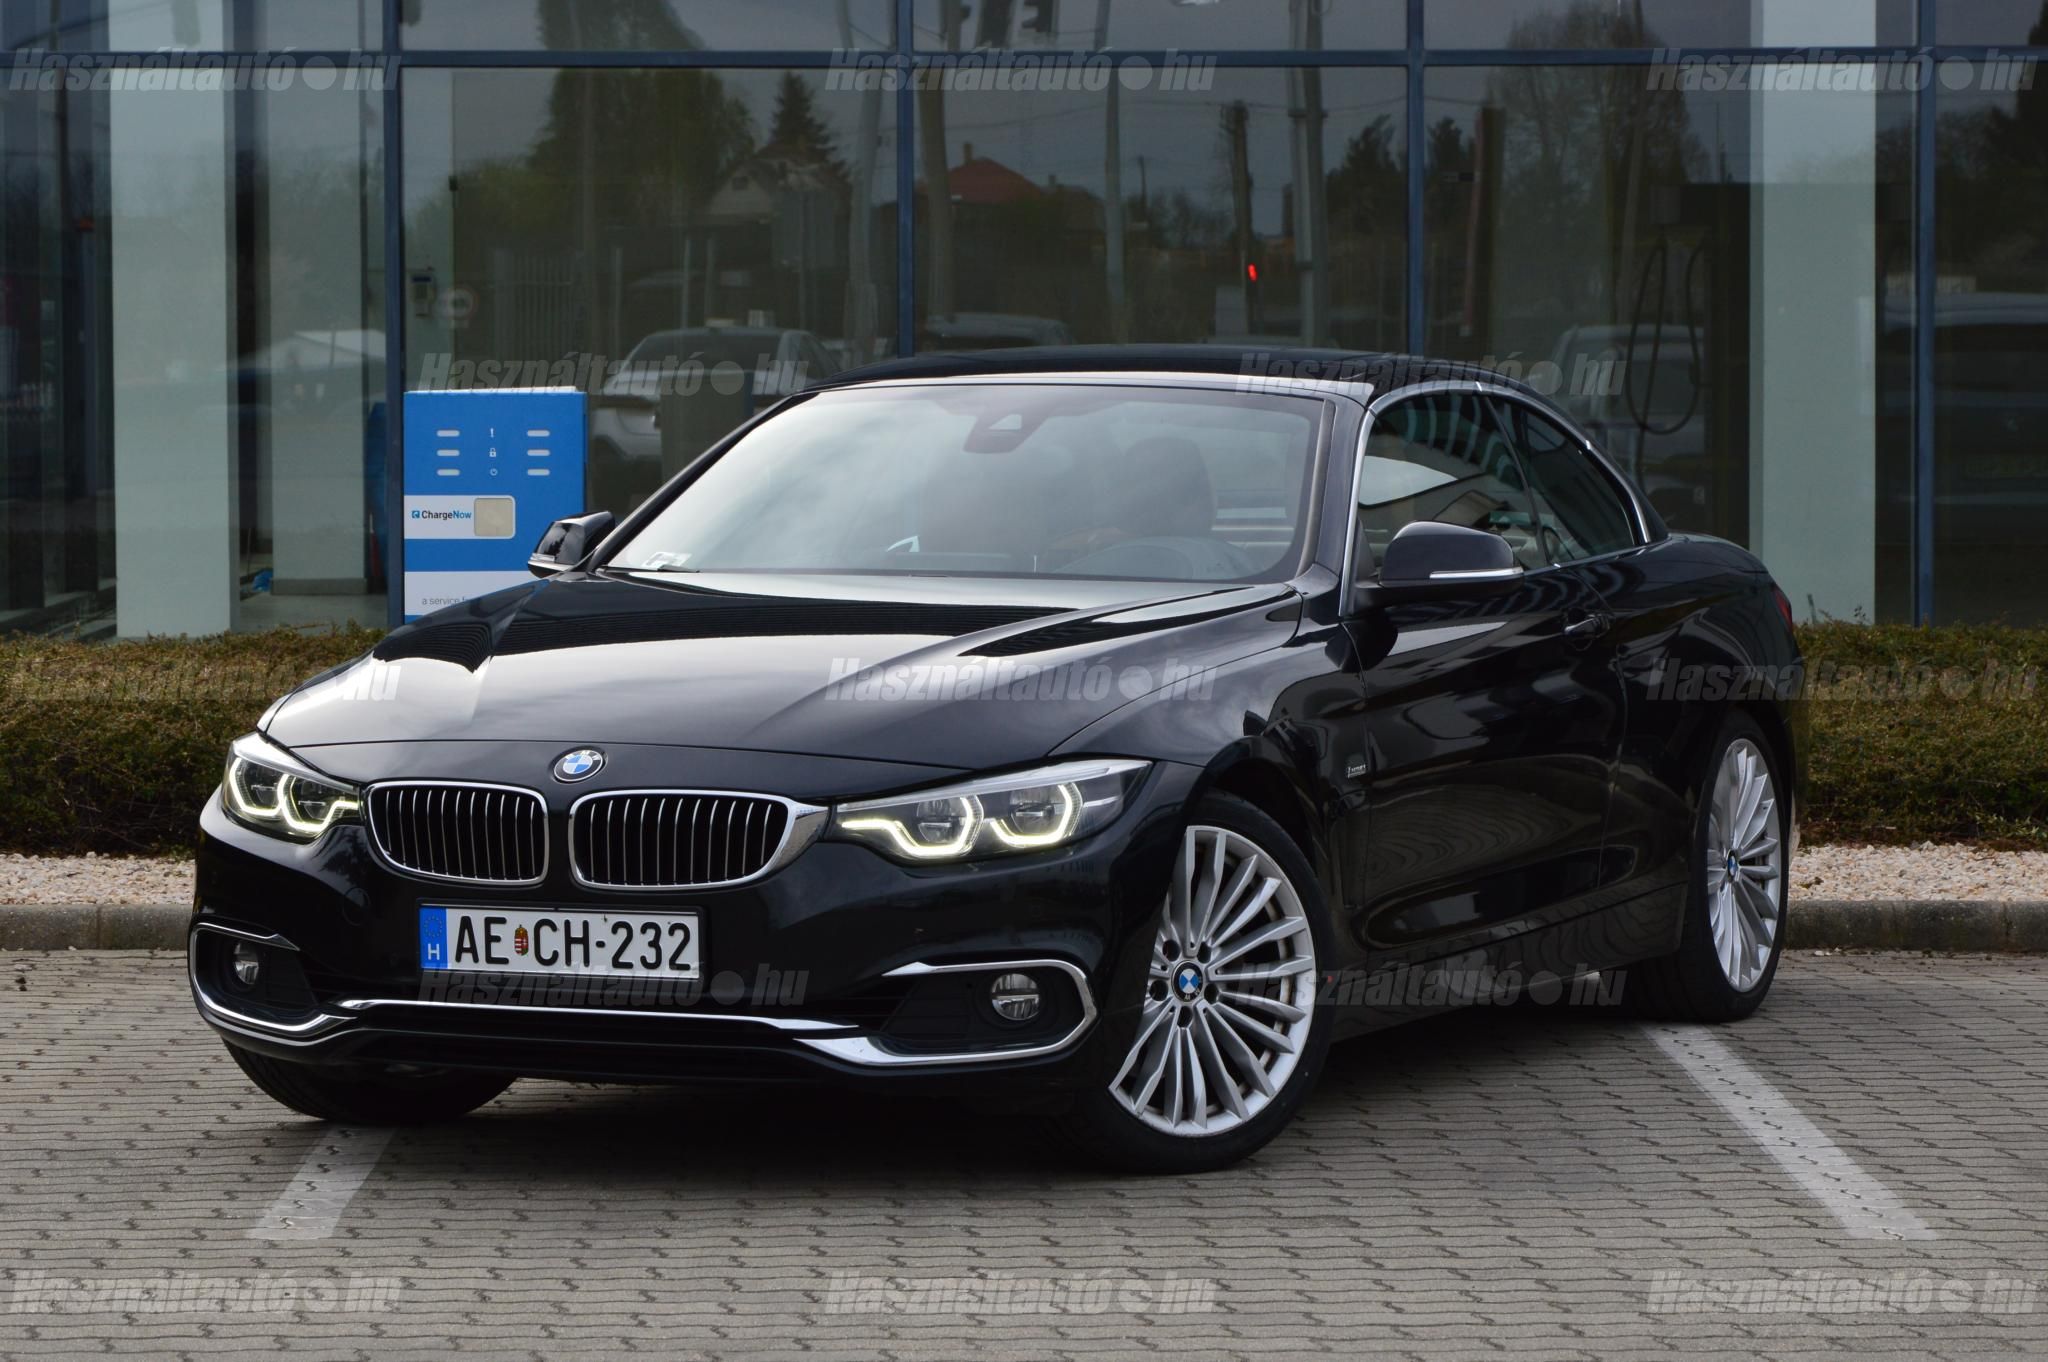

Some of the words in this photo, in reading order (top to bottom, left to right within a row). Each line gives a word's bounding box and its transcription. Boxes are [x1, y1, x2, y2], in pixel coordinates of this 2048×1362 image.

[421, 510, 472, 520] ChargeNow
[455, 915, 510, 965] AE
[427, 943, 441, 961] H
